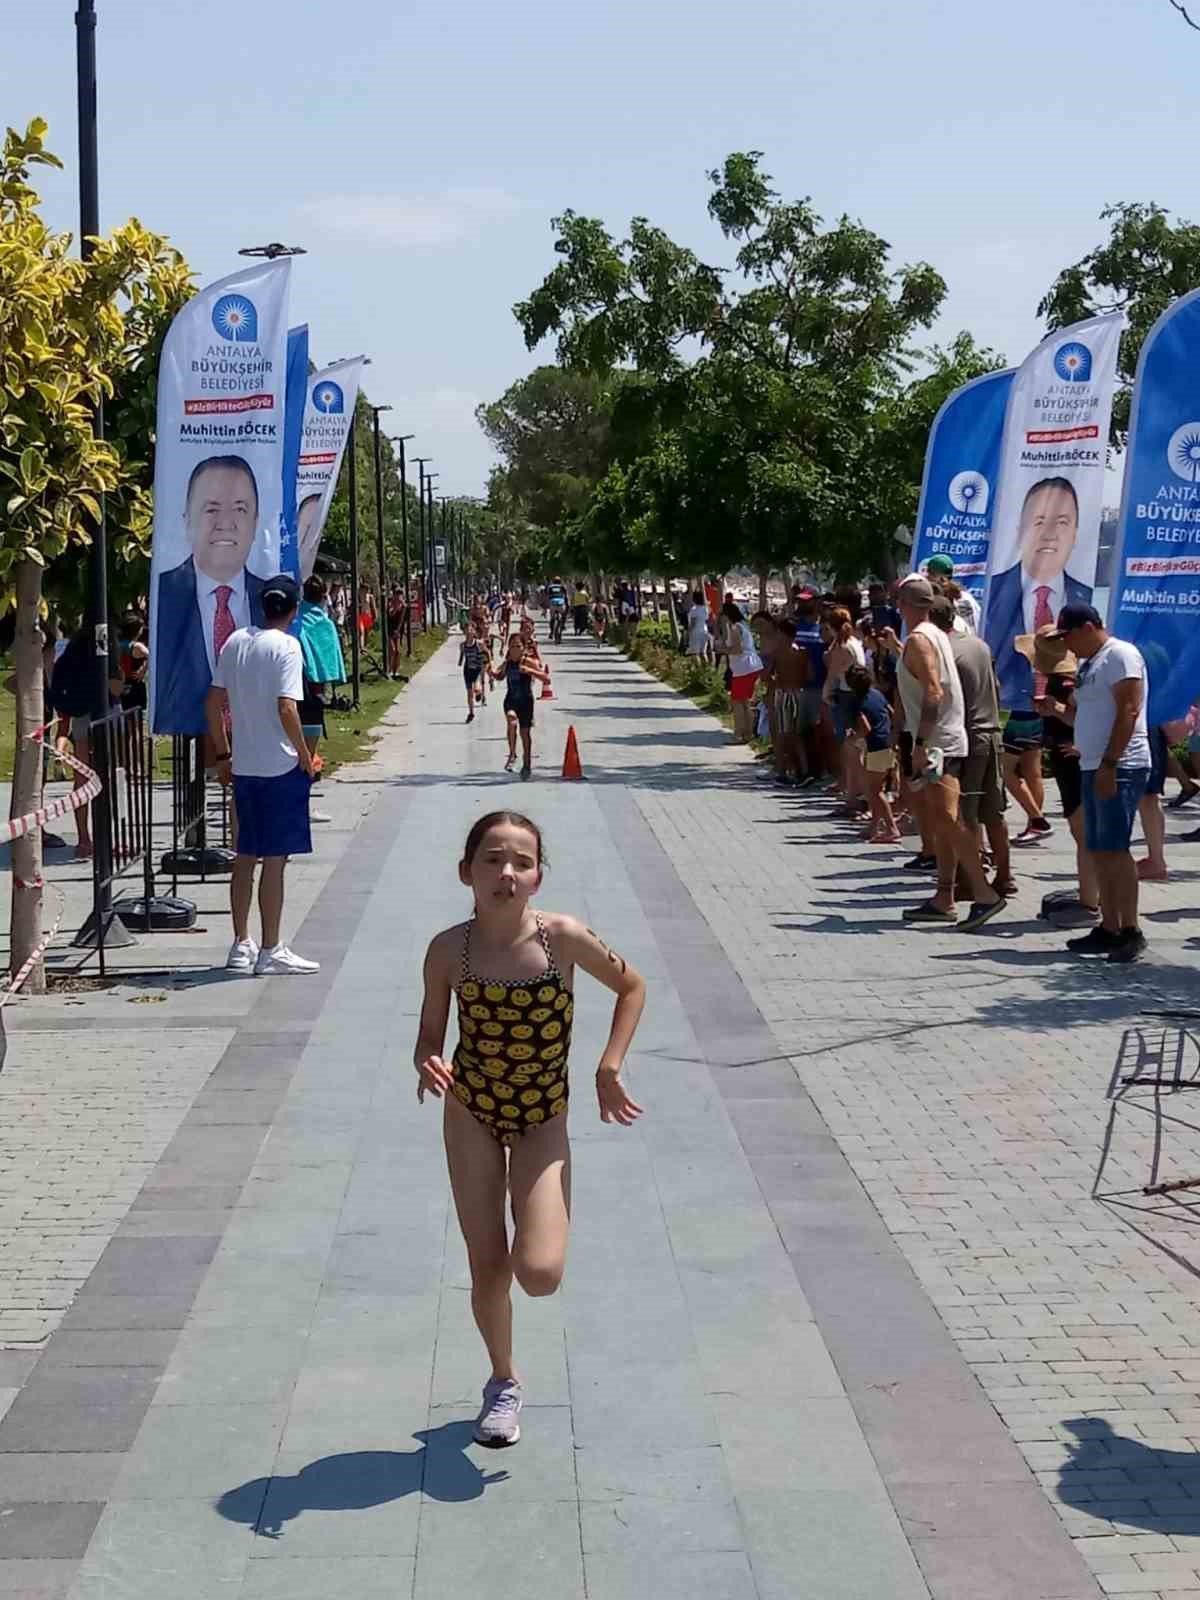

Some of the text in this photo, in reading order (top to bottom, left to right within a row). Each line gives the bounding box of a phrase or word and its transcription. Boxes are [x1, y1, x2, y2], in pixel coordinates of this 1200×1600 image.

[207, 345, 262, 358] ANTALYA
[191, 359, 273, 376] BÜYÜKŞEHİR
[200, 376, 264, 390] BELEDİYESİ
[180, 421, 277, 436] Muhittin BÖCEK
[1065, 449, 1099, 460] BÖCEK
[940, 514, 986, 527] ANTALYA
